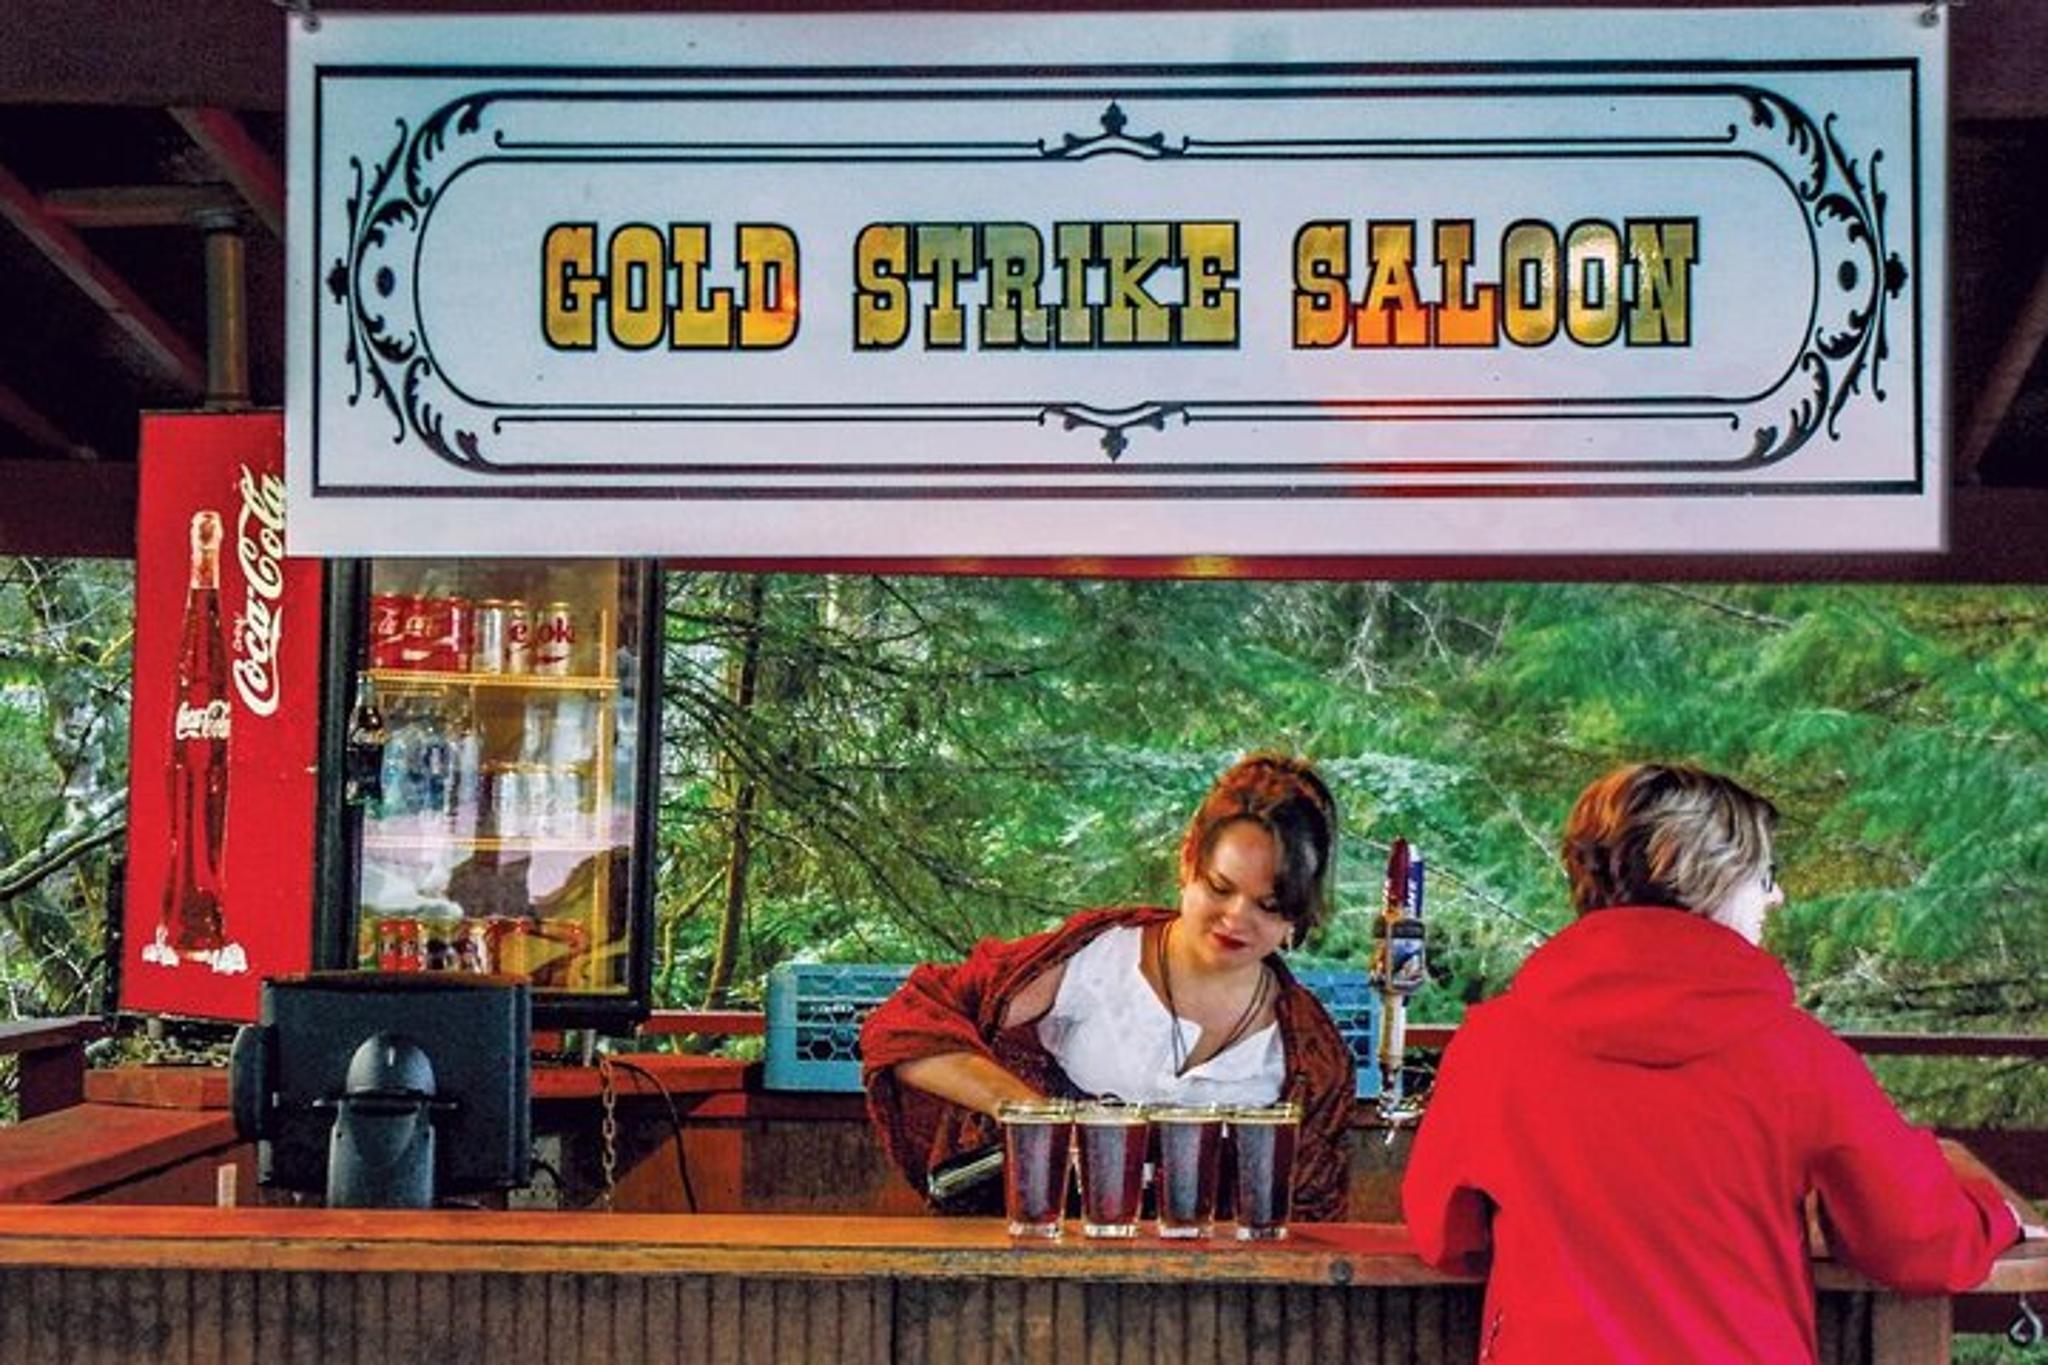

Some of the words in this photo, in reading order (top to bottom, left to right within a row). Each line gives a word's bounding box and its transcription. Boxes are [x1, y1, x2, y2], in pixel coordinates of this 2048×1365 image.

[541, 222, 800, 351] GOLD
[852, 220, 1239, 351] STRIKE
[1292, 216, 1699, 349] SALOON
